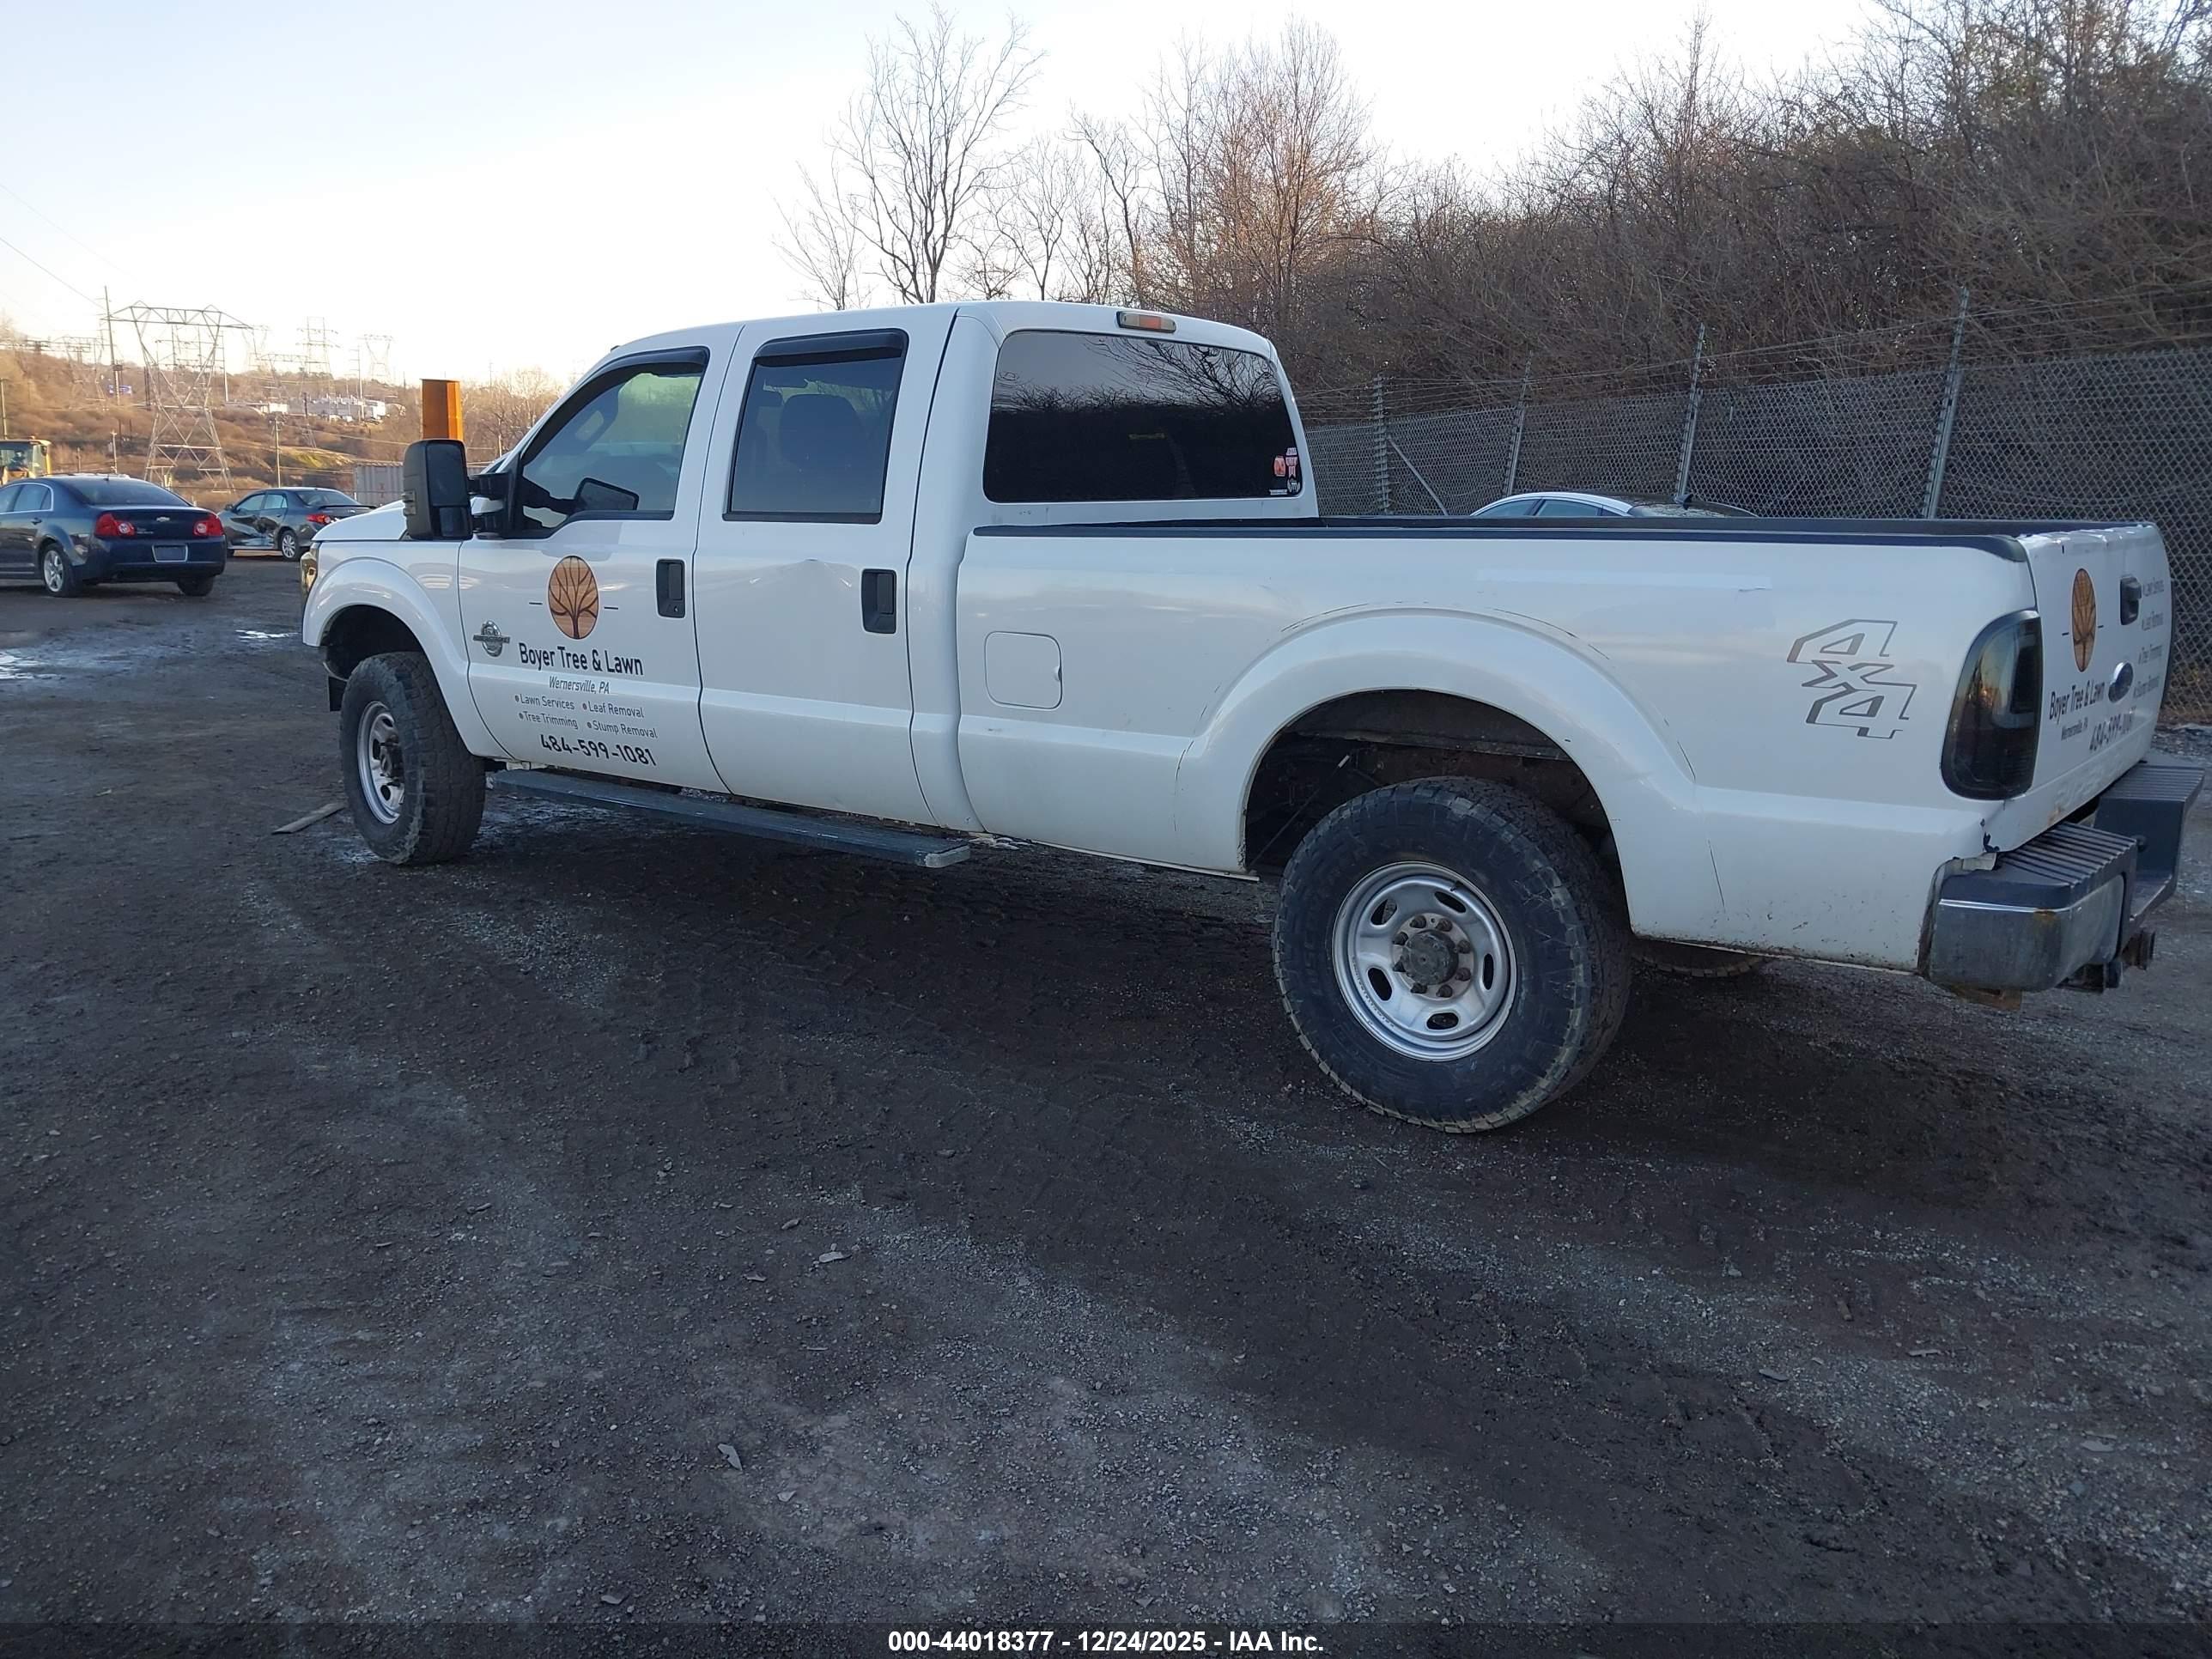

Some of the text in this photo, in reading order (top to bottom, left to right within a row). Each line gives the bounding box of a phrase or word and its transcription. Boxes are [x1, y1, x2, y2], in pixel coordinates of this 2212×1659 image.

[519, 642, 643, 675] Boyer Tree & Lawn
[550, 675, 610, 695] Wernersville, PA
[520, 694, 574, 710] Lawn Services
[588, 700, 645, 718] Leaf Removal
[2050, 690, 2069, 726] Boyer
[2070, 684, 2084, 712] Tree
[523, 711, 578, 730] Tree Trimming
[592, 720, 658, 738] Stump Removal
[541, 734, 657, 766] 484-599-1081
